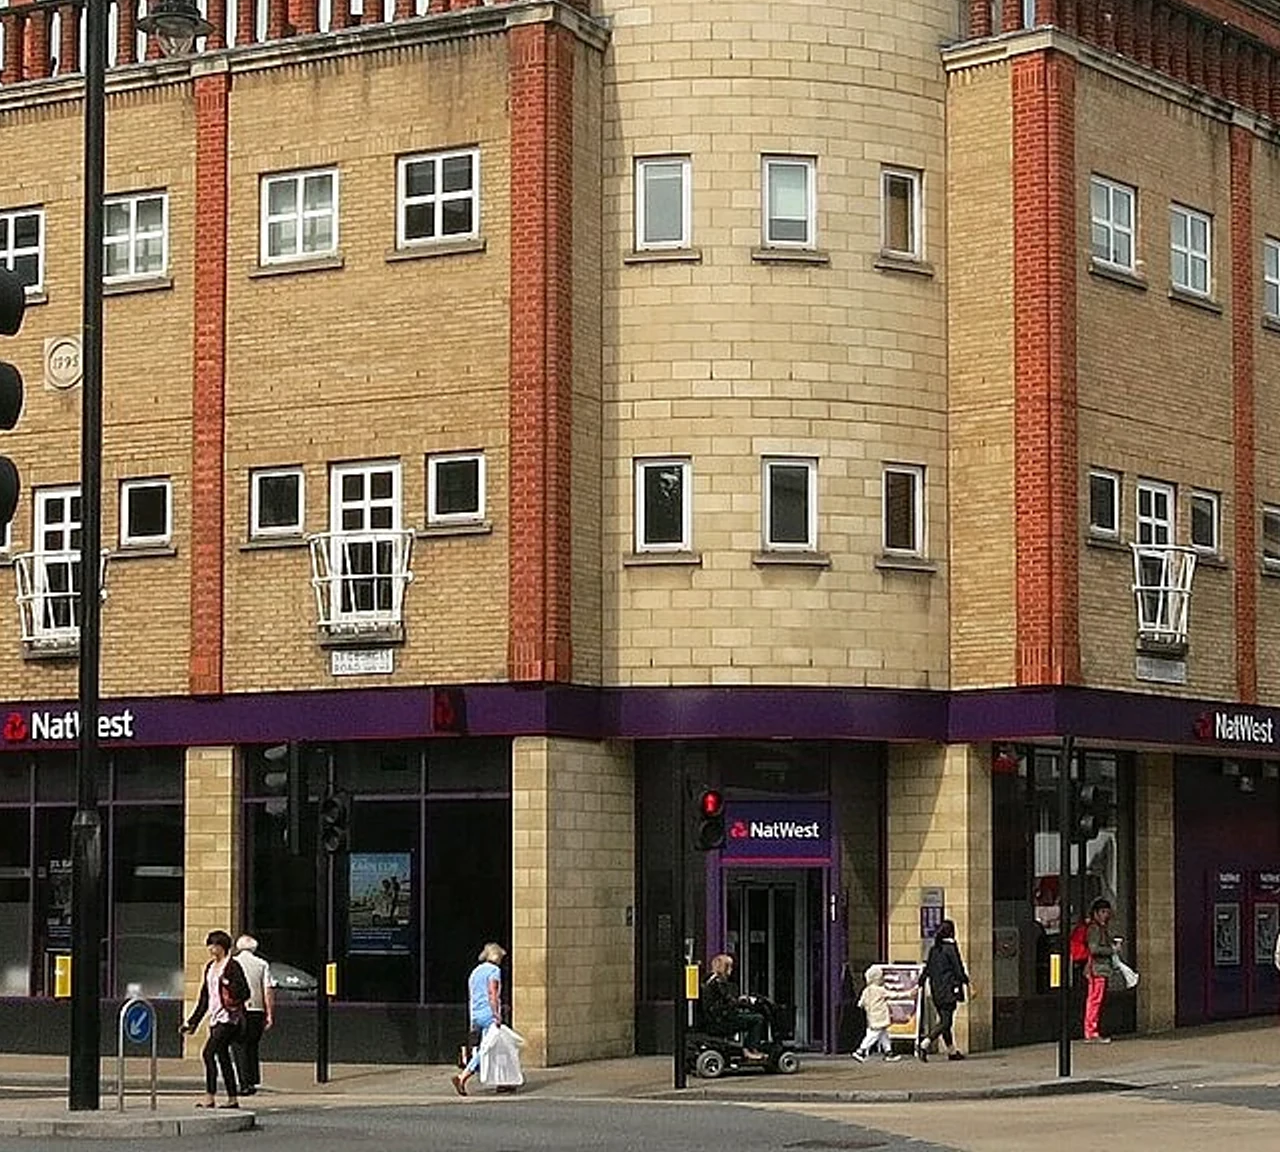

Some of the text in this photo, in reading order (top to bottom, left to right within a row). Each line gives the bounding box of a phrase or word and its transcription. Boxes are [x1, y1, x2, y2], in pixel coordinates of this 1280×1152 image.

[31, 709, 134, 740] Natest
[1214, 711, 1274, 743] NatWest
[750, 821, 820, 838] NatWest
